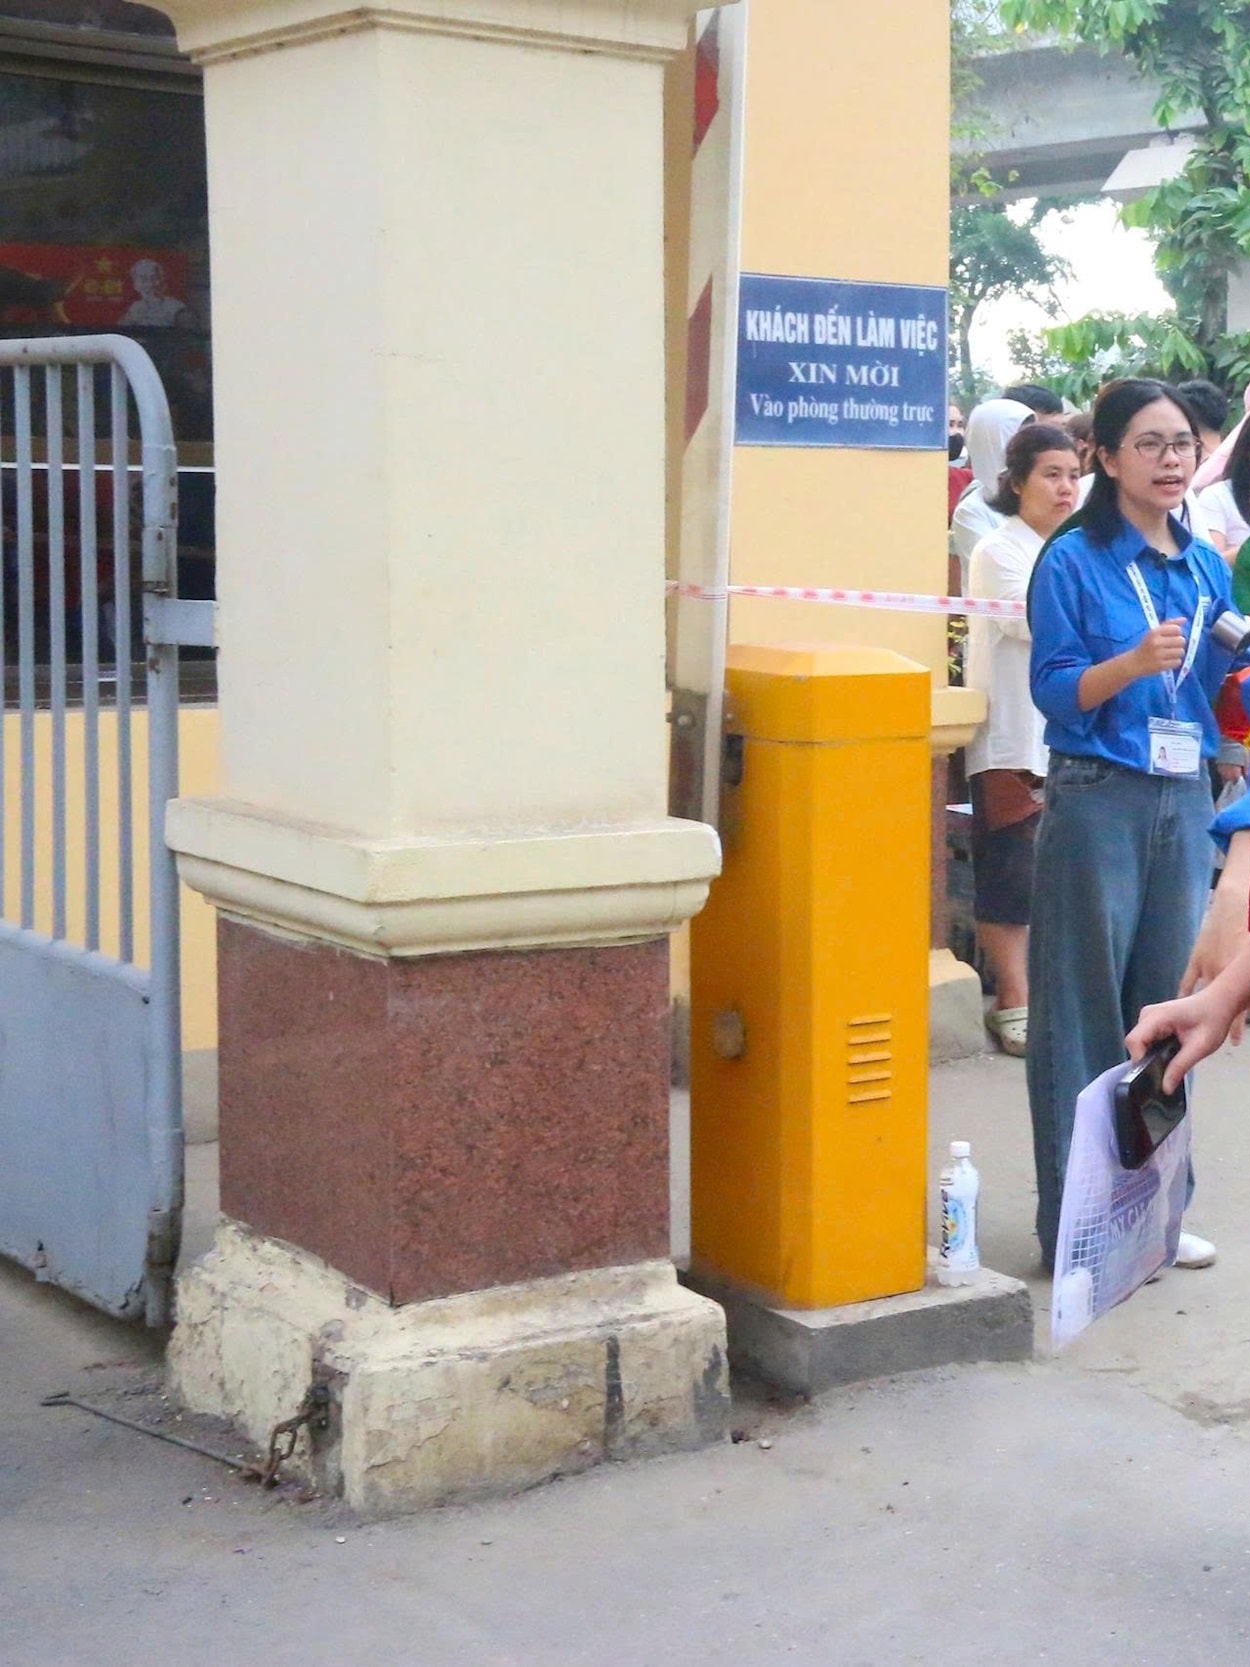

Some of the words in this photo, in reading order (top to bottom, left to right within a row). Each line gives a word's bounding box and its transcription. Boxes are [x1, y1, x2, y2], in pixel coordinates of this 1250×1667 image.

[746, 305, 809, 344] KHÁCH
[814, 304, 851, 346] ĐẾN
[856, 310, 895, 348] LÀM
[900, 313, 938, 357] VIỆC
[788, 361, 837, 384] XIN
[845, 360, 900, 387] MỜI
[750, 393, 784, 417] Vào
[788, 395, 839, 424] phòng
[843, 397, 899, 426] thường
[903, 402, 934, 426] trực
